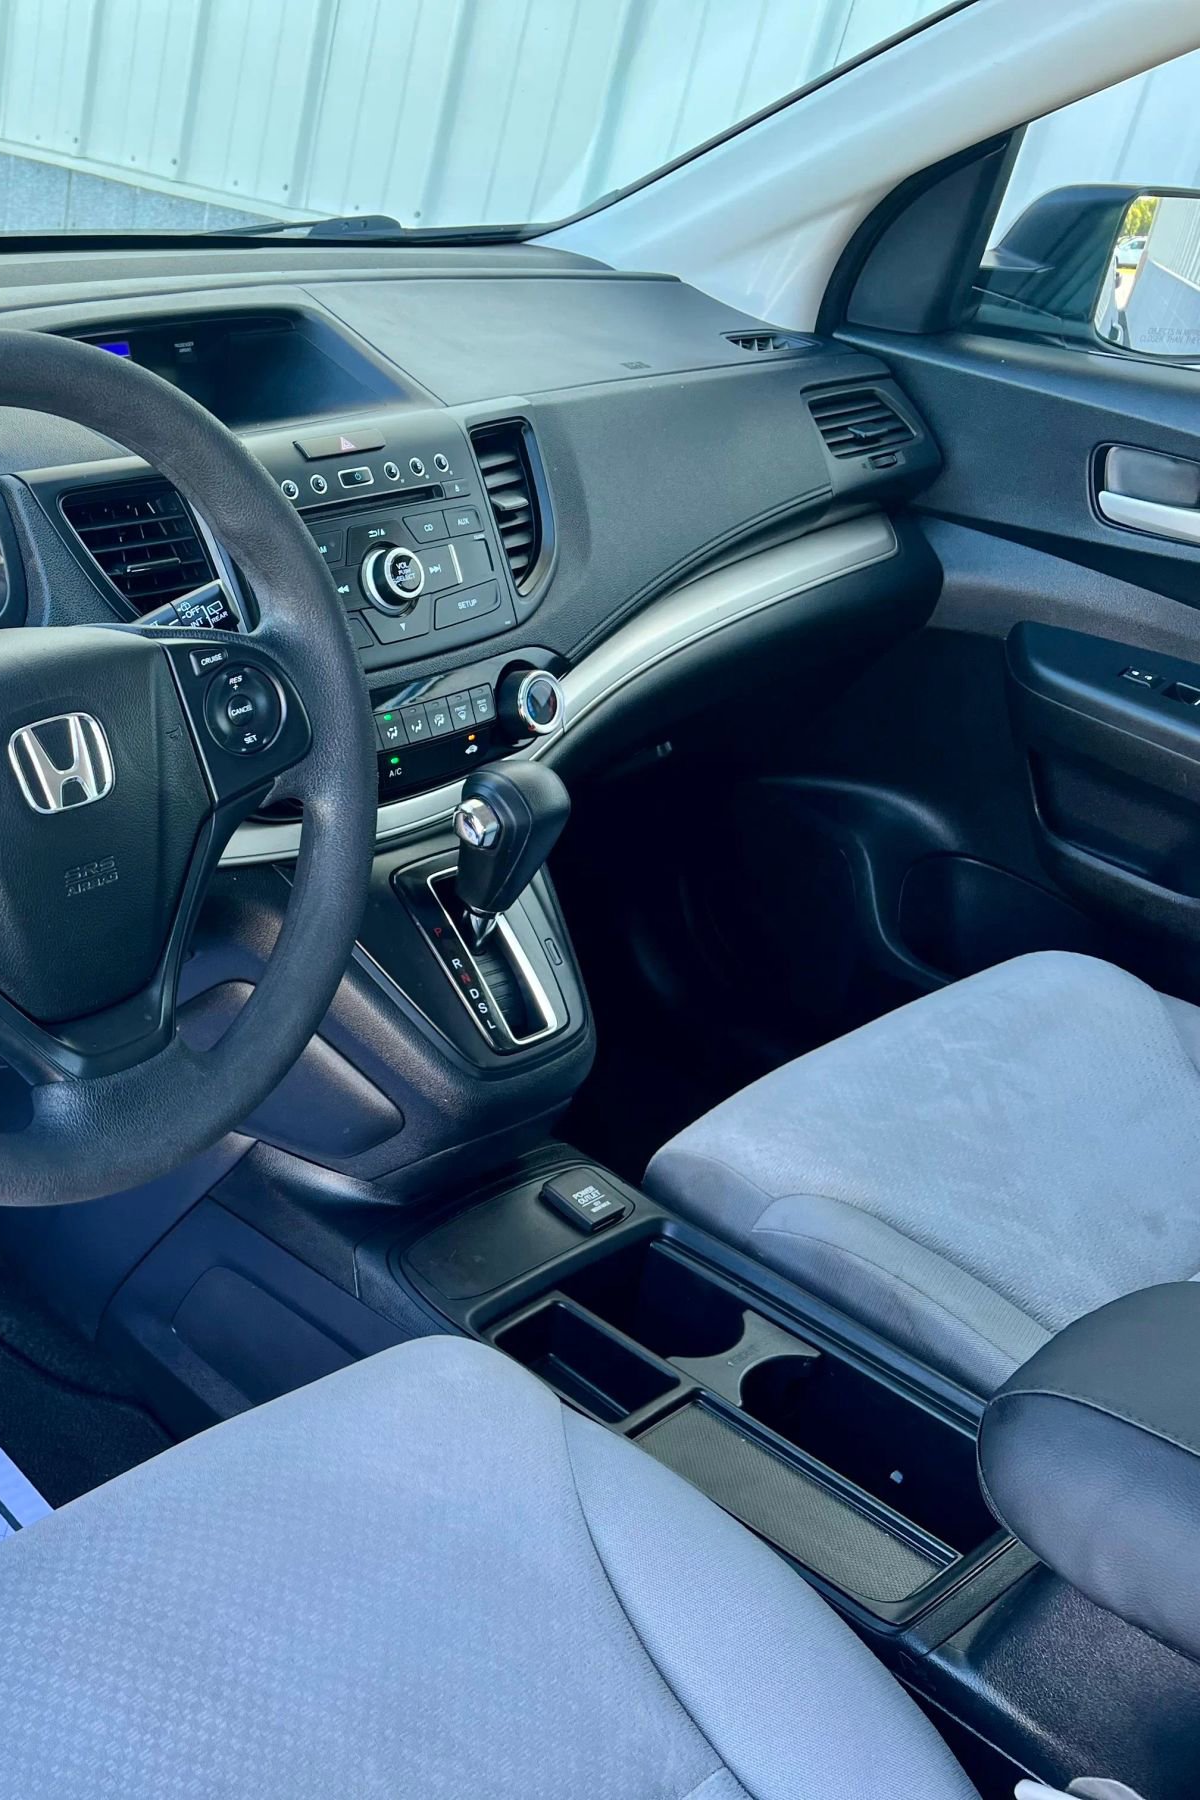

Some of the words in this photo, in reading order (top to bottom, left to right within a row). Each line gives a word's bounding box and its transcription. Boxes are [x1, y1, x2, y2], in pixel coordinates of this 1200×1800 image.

[288, 484, 296, 492] 2
[423, 523, 434, 532] CD
[457, 518, 470, 526] AUX
[396, 562, 409, 570] VOL
[457, 599, 478, 610] SETUP
[185, 604, 201, 619] OFF
[211, 610, 229, 624] REAR
[190, 616, 204, 627] INT
[201, 653, 223, 666] CRUISE
[229, 675, 243, 685] RES
[231, 704, 253, 717] CANCEL
[243, 734, 258, 744] SET
[389, 767, 402, 778] A/C
[64, 855, 115, 883] SRS
[434, 927, 442, 937] P
[451, 958, 462, 969] R
[470, 988, 480, 999] D
[478, 1002, 488, 1013] S
[487, 1019, 496, 1029] L
[578, 1189, 601, 1205] OUTLET
